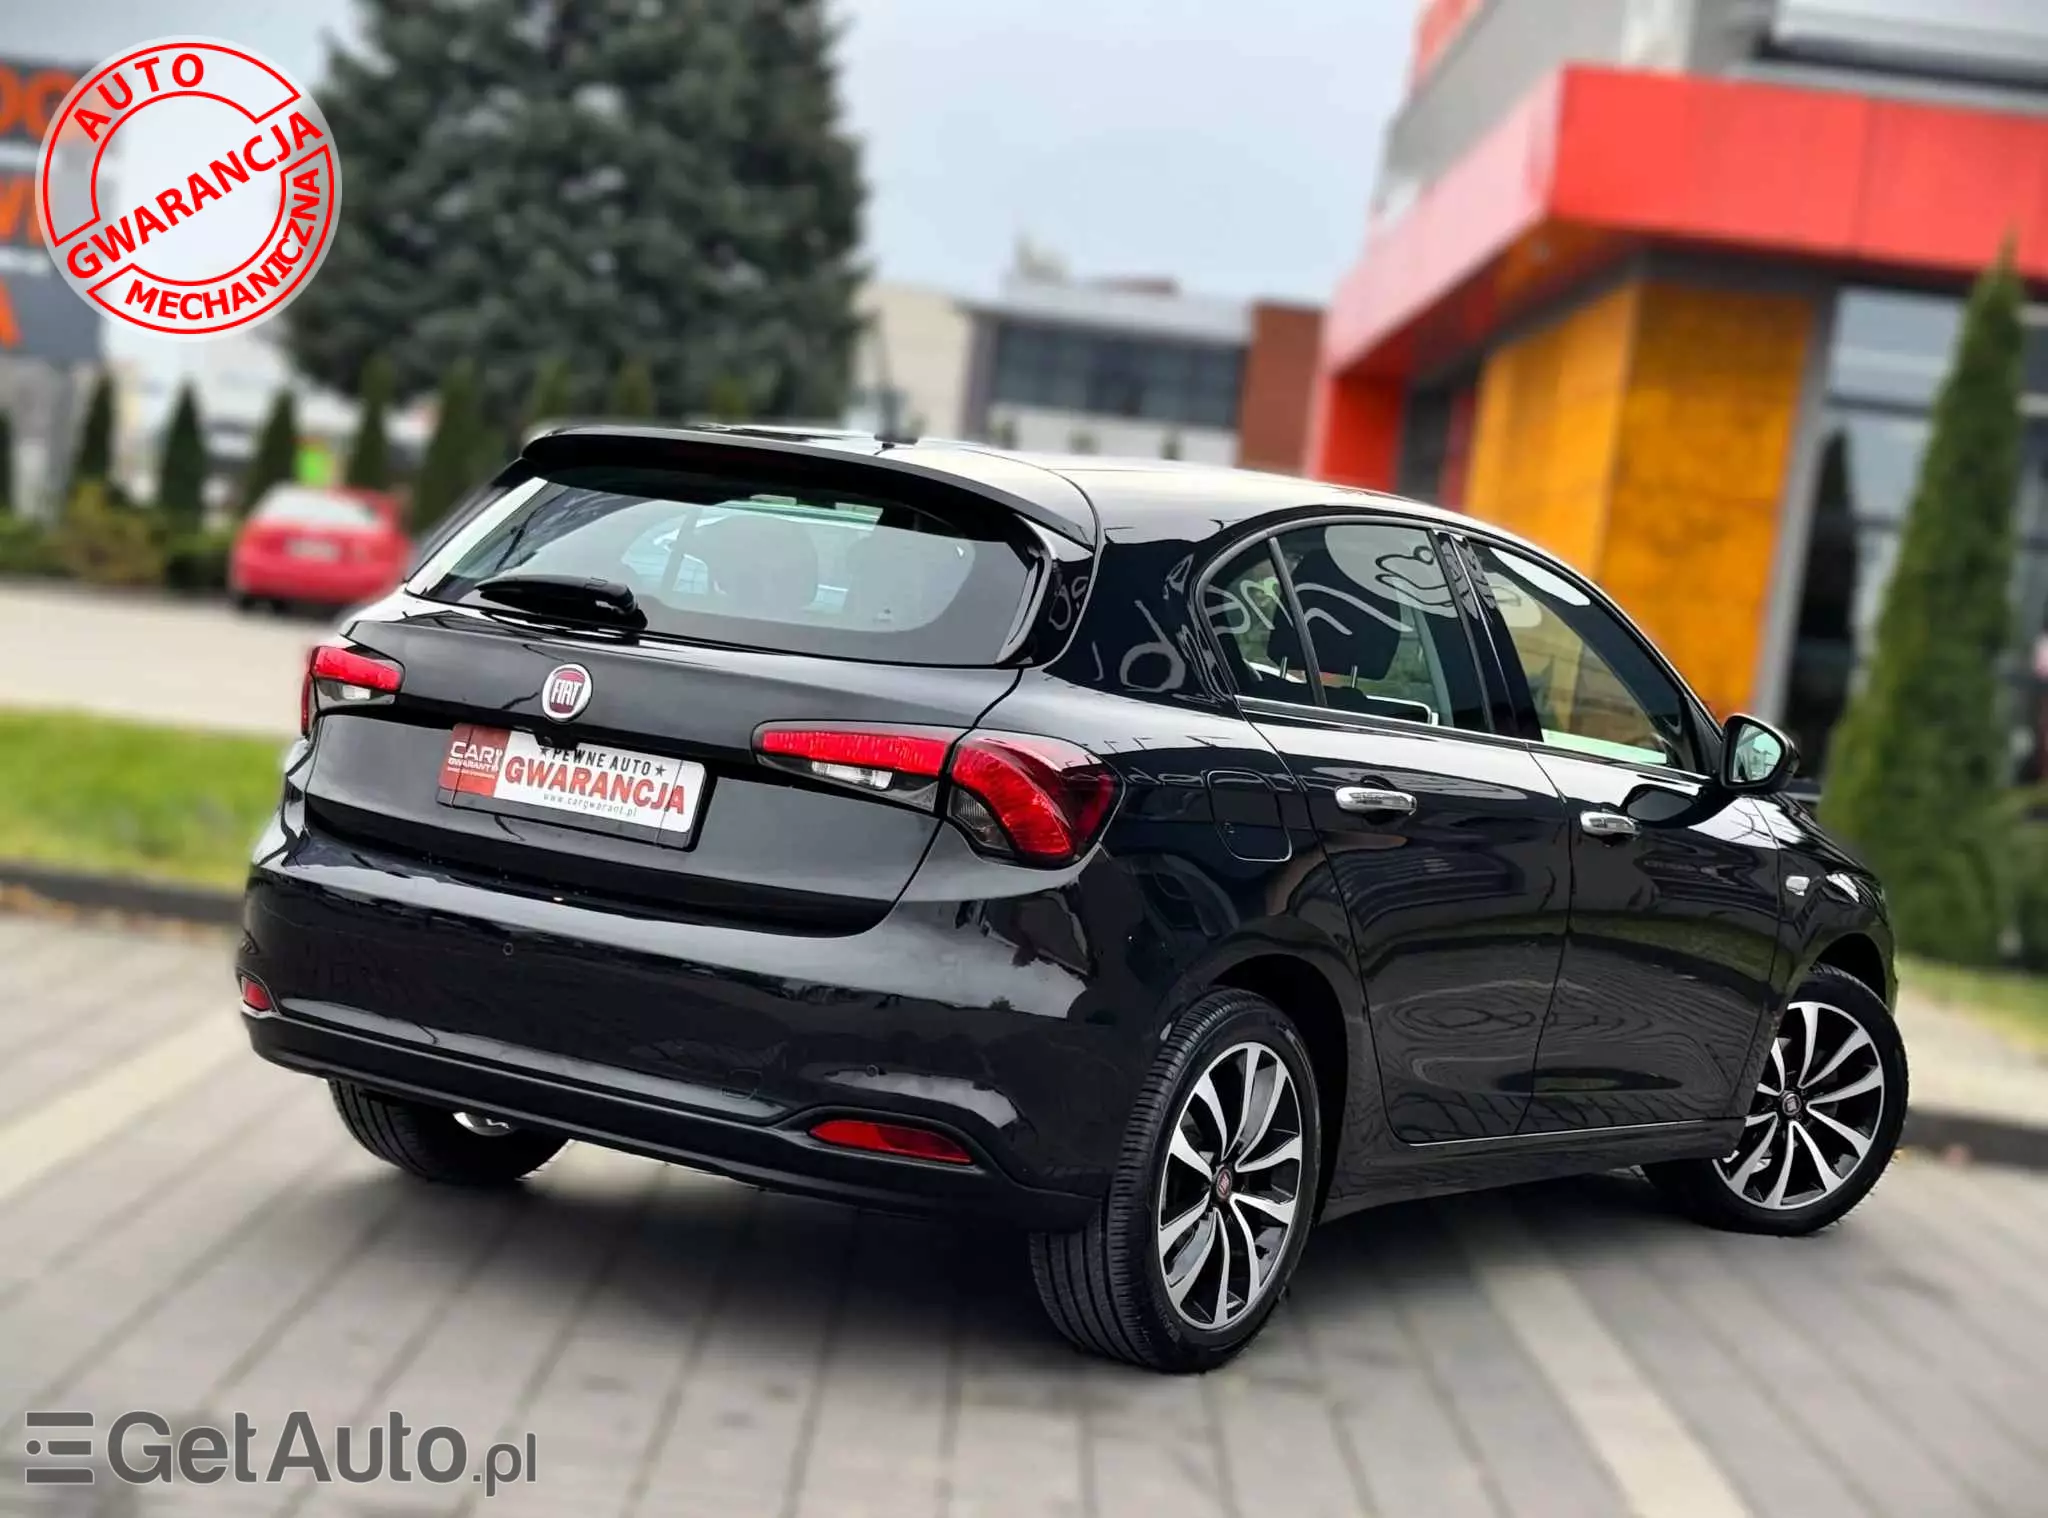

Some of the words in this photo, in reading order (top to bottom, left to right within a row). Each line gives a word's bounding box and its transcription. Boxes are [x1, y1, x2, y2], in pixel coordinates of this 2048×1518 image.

[551, 679, 584, 707] FIAT
[552, 748, 606, 768] PEWNE
[609, 755, 652, 776] AUTO
[505, 756, 685, 815] GWARANCJA
